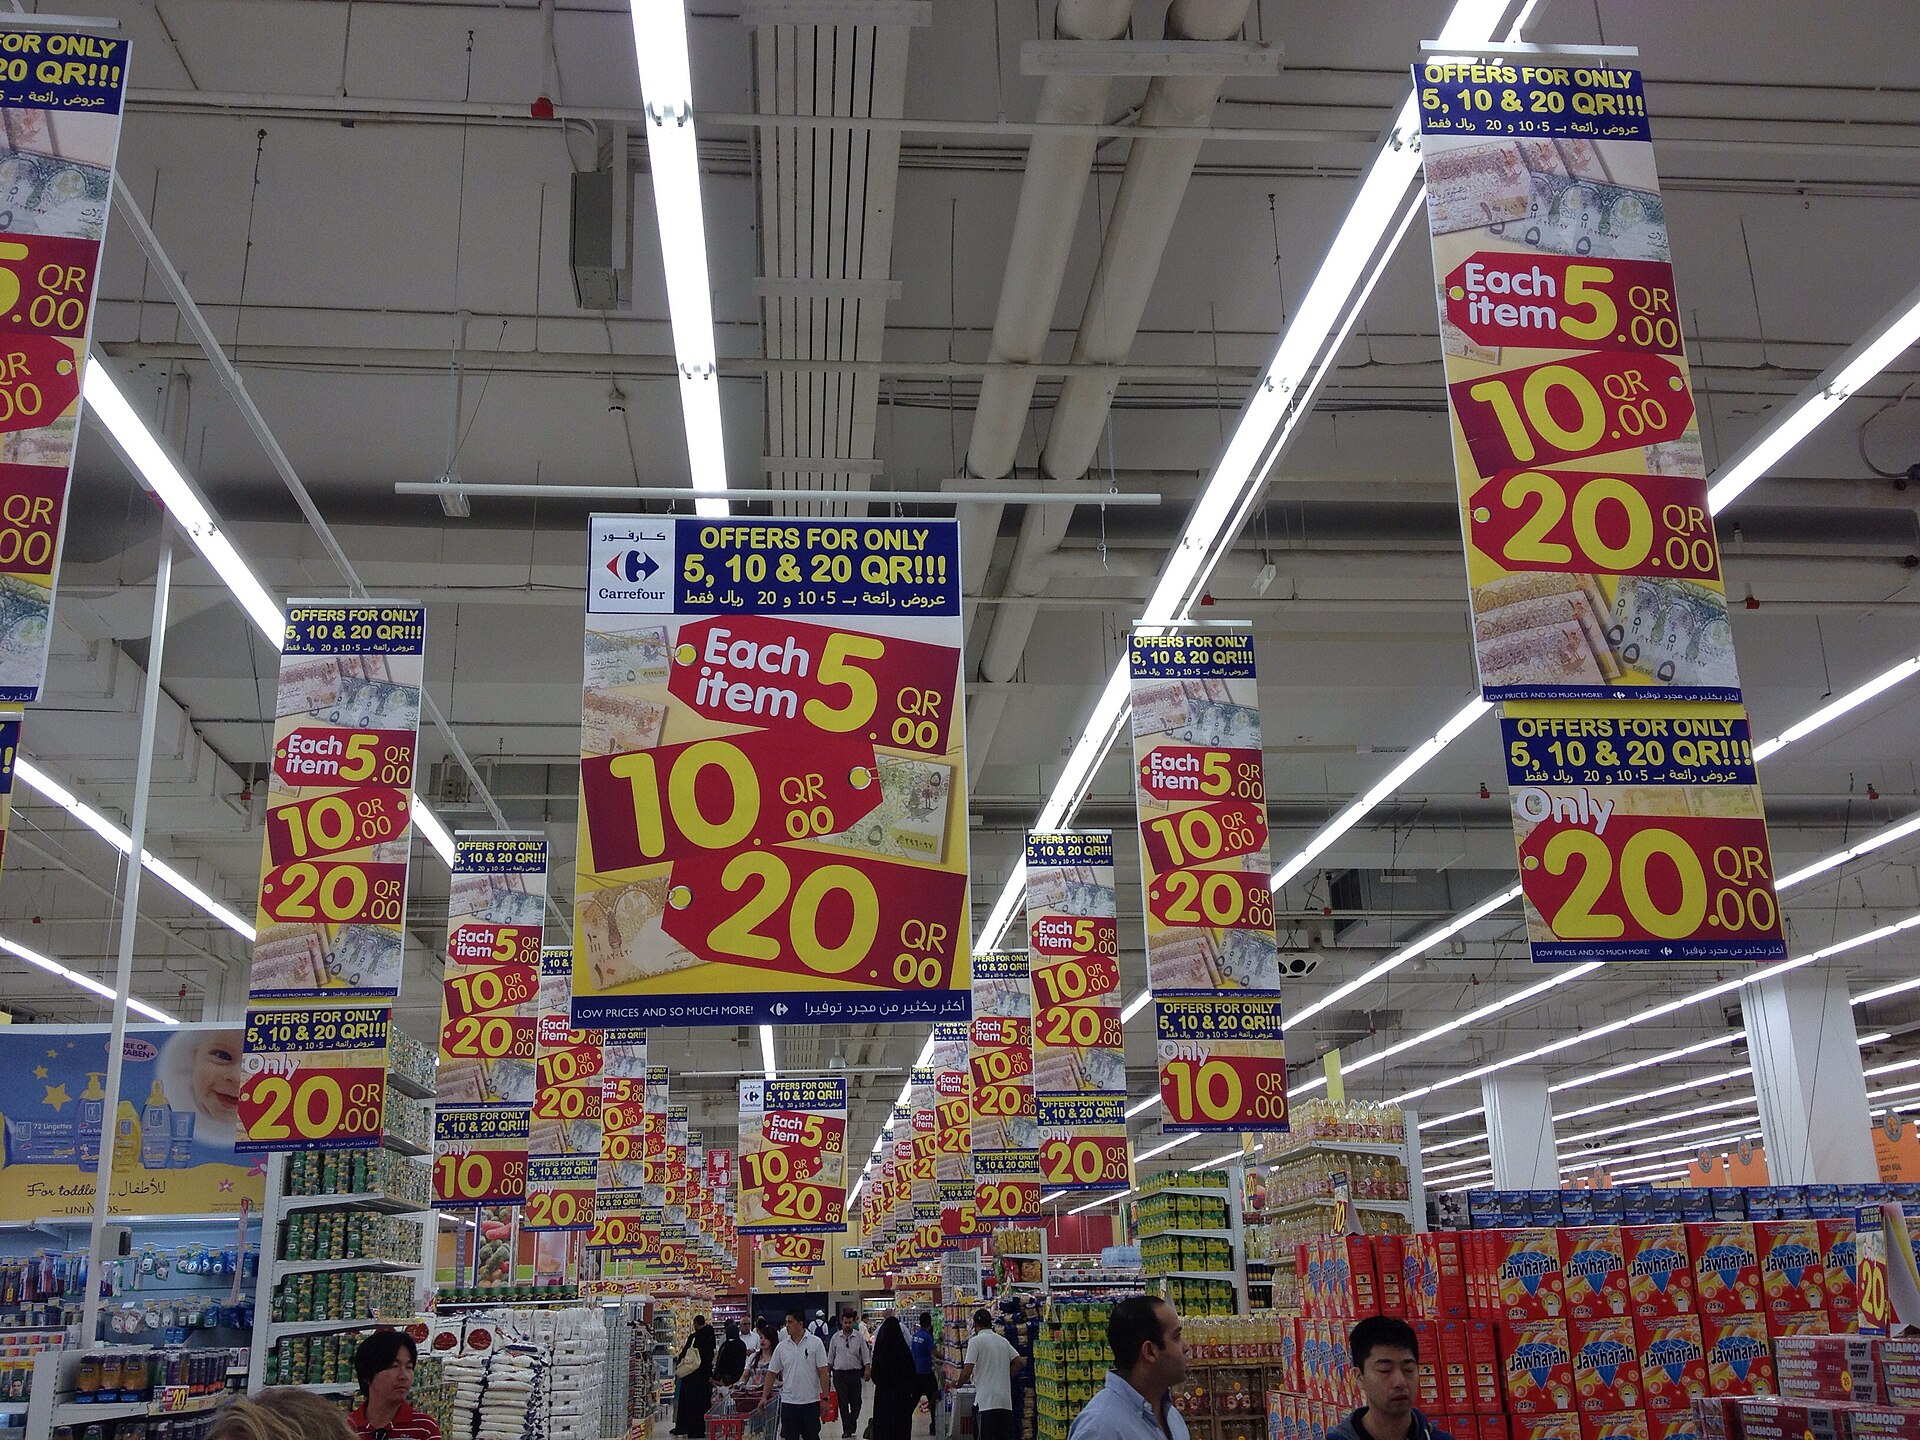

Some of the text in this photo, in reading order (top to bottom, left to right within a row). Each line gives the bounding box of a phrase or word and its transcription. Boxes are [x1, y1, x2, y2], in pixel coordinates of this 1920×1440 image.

[47, 35, 116, 58] ONLY
[36, 61, 119, 88] QR!!!
[1424, 64, 1633, 89] OFFERS FOR ONLY
[29, 91, 104, 106] عروض رائعة
[1423, 89, 1644, 117] 5, 10 & 20 QR!!!
[38, 264, 86, 295] QR
[1465, 263, 1557, 298] Each
[1628, 285, 1672, 315] QR
[1469, 294, 1557, 329] item
[1603, 369, 1650, 402] QR
[3, 495, 54, 528] QR
[1662, 505, 1707, 537] QR
[701, 527, 928, 551] OFFERS FOR ONLY
[684, 554, 946, 587] 5, 10 & 20 QR!!!
[599, 588, 665, 601] Carrefour
[685, 590, 713, 604] فقط
[720, 590, 744, 607] ريال
[758, 591, 776, 604] 20
[783, 596, 791, 607] و
[863, 591, 896, 607] رائعة
[902, 593, 945, 607] عروض
[291, 610, 418, 621] OFFERS FOR ONLY
[307, 625, 327, 638] 10
[332, 625, 345, 638] &
[350, 625, 372, 638] 20
[376, 625, 421, 640] QR!!!
[704, 627, 810, 677] Each
[696, 667, 798, 718] item
[897, 687, 942, 718] QR
[1518, 720, 1734, 737] OFFERS FOR ONLY
[288, 735, 342, 755] Each
[384, 746, 410, 764] QR
[286, 752, 338, 775] item
[1151, 752, 1199, 772] Each
[1511, 741, 1752, 770] 5, 10 & 20 QR!!!
[1152, 770, 1198, 790] item
[1238, 764, 1260, 780] QR
[780, 773, 827, 804] QR
[357, 799, 384, 819] QR
[1516, 788, 1614, 835] Only
[1222, 812, 1246, 831] QR
[1714, 846, 1768, 886] QR
[374, 880, 400, 899] QR
[1249, 888, 1270, 906] QR
[457, 929, 494, 943] Each
[901, 920, 947, 954] QR
[456, 942, 491, 957] item
[577, 1005, 753, 1019] LOW PRICES AND SO MUCH MORE!
[847, 1003, 875, 1015] مجرد
[880, 1003, 898, 1014] من
[901, 1000, 936, 1014] بكثير
[939, 997, 964, 1014] أكثر
[1160, 1041, 1210, 1065] Only
[243, 1053, 300, 1081] Only
[771, 1082, 799, 1090] OFFERS
[818, 1081, 837, 1089] ONLY
[1256, 1073, 1283, 1093] QR
[350, 1083, 380, 1107] QR
[778, 1091, 790, 1100] 10
[793, 1091, 800, 1100] &
[803, 1091, 815, 1100] 20
[772, 1115, 802, 1130] Each
[770, 1127, 799, 1143] item
[1040, 1127, 1074, 1143] Only
[435, 1141, 473, 1158] Only
[28, 1182, 55, 1196] For
[1502, 1256, 1558, 1280] Jawharah
[1566, 1254, 1622, 1278] Jawharah
[1631, 1253, 1687, 1277] Jawharah
[1700, 1251, 1754, 1273] Jawharah
[1765, 1249, 1819, 1272] Jawharah
[1711, 1341, 1767, 1365] Jawharah
[1778, 1340, 1815, 1350] DIAMOND
[1510, 1348, 1567, 1372] Jawharah
[1577, 1346, 1635, 1370] Jawharah
[1644, 1344, 1700, 1368] Jawharah
[1781, 1360, 1817, 1370] DIAMOND
